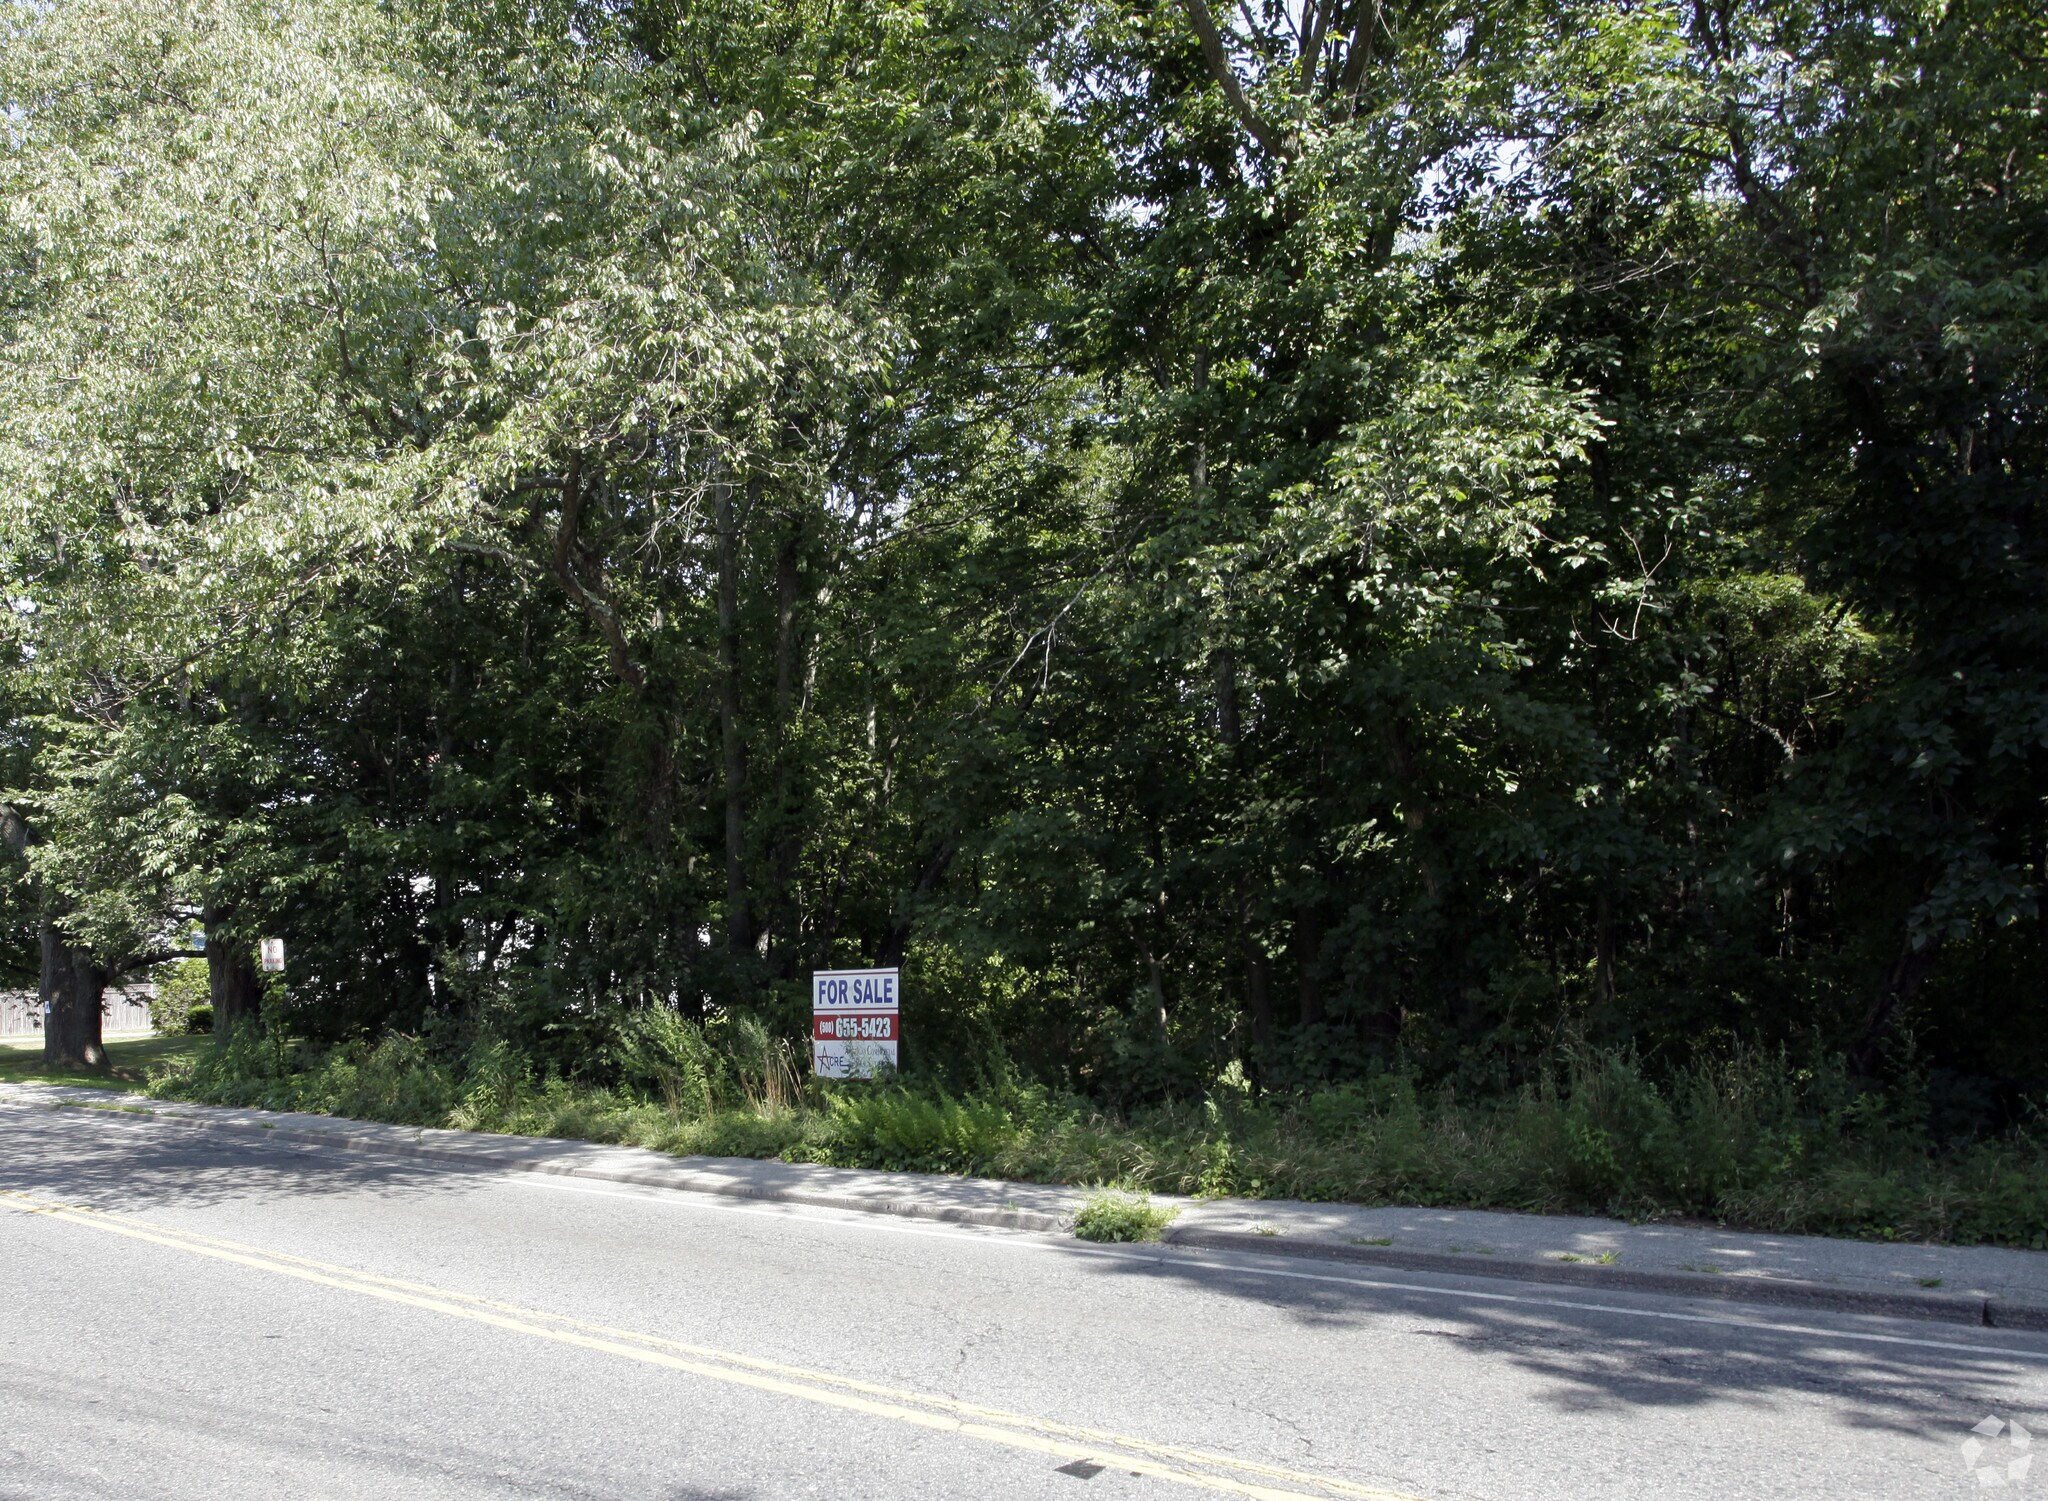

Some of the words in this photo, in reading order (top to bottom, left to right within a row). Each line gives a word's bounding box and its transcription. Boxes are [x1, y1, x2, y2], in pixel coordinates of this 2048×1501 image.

[268, 945, 277, 954] NO
[819, 980, 848, 1004] FOR
[853, 978, 893, 1004] SALE
[835, 1017, 891, 1038] 655-5423
